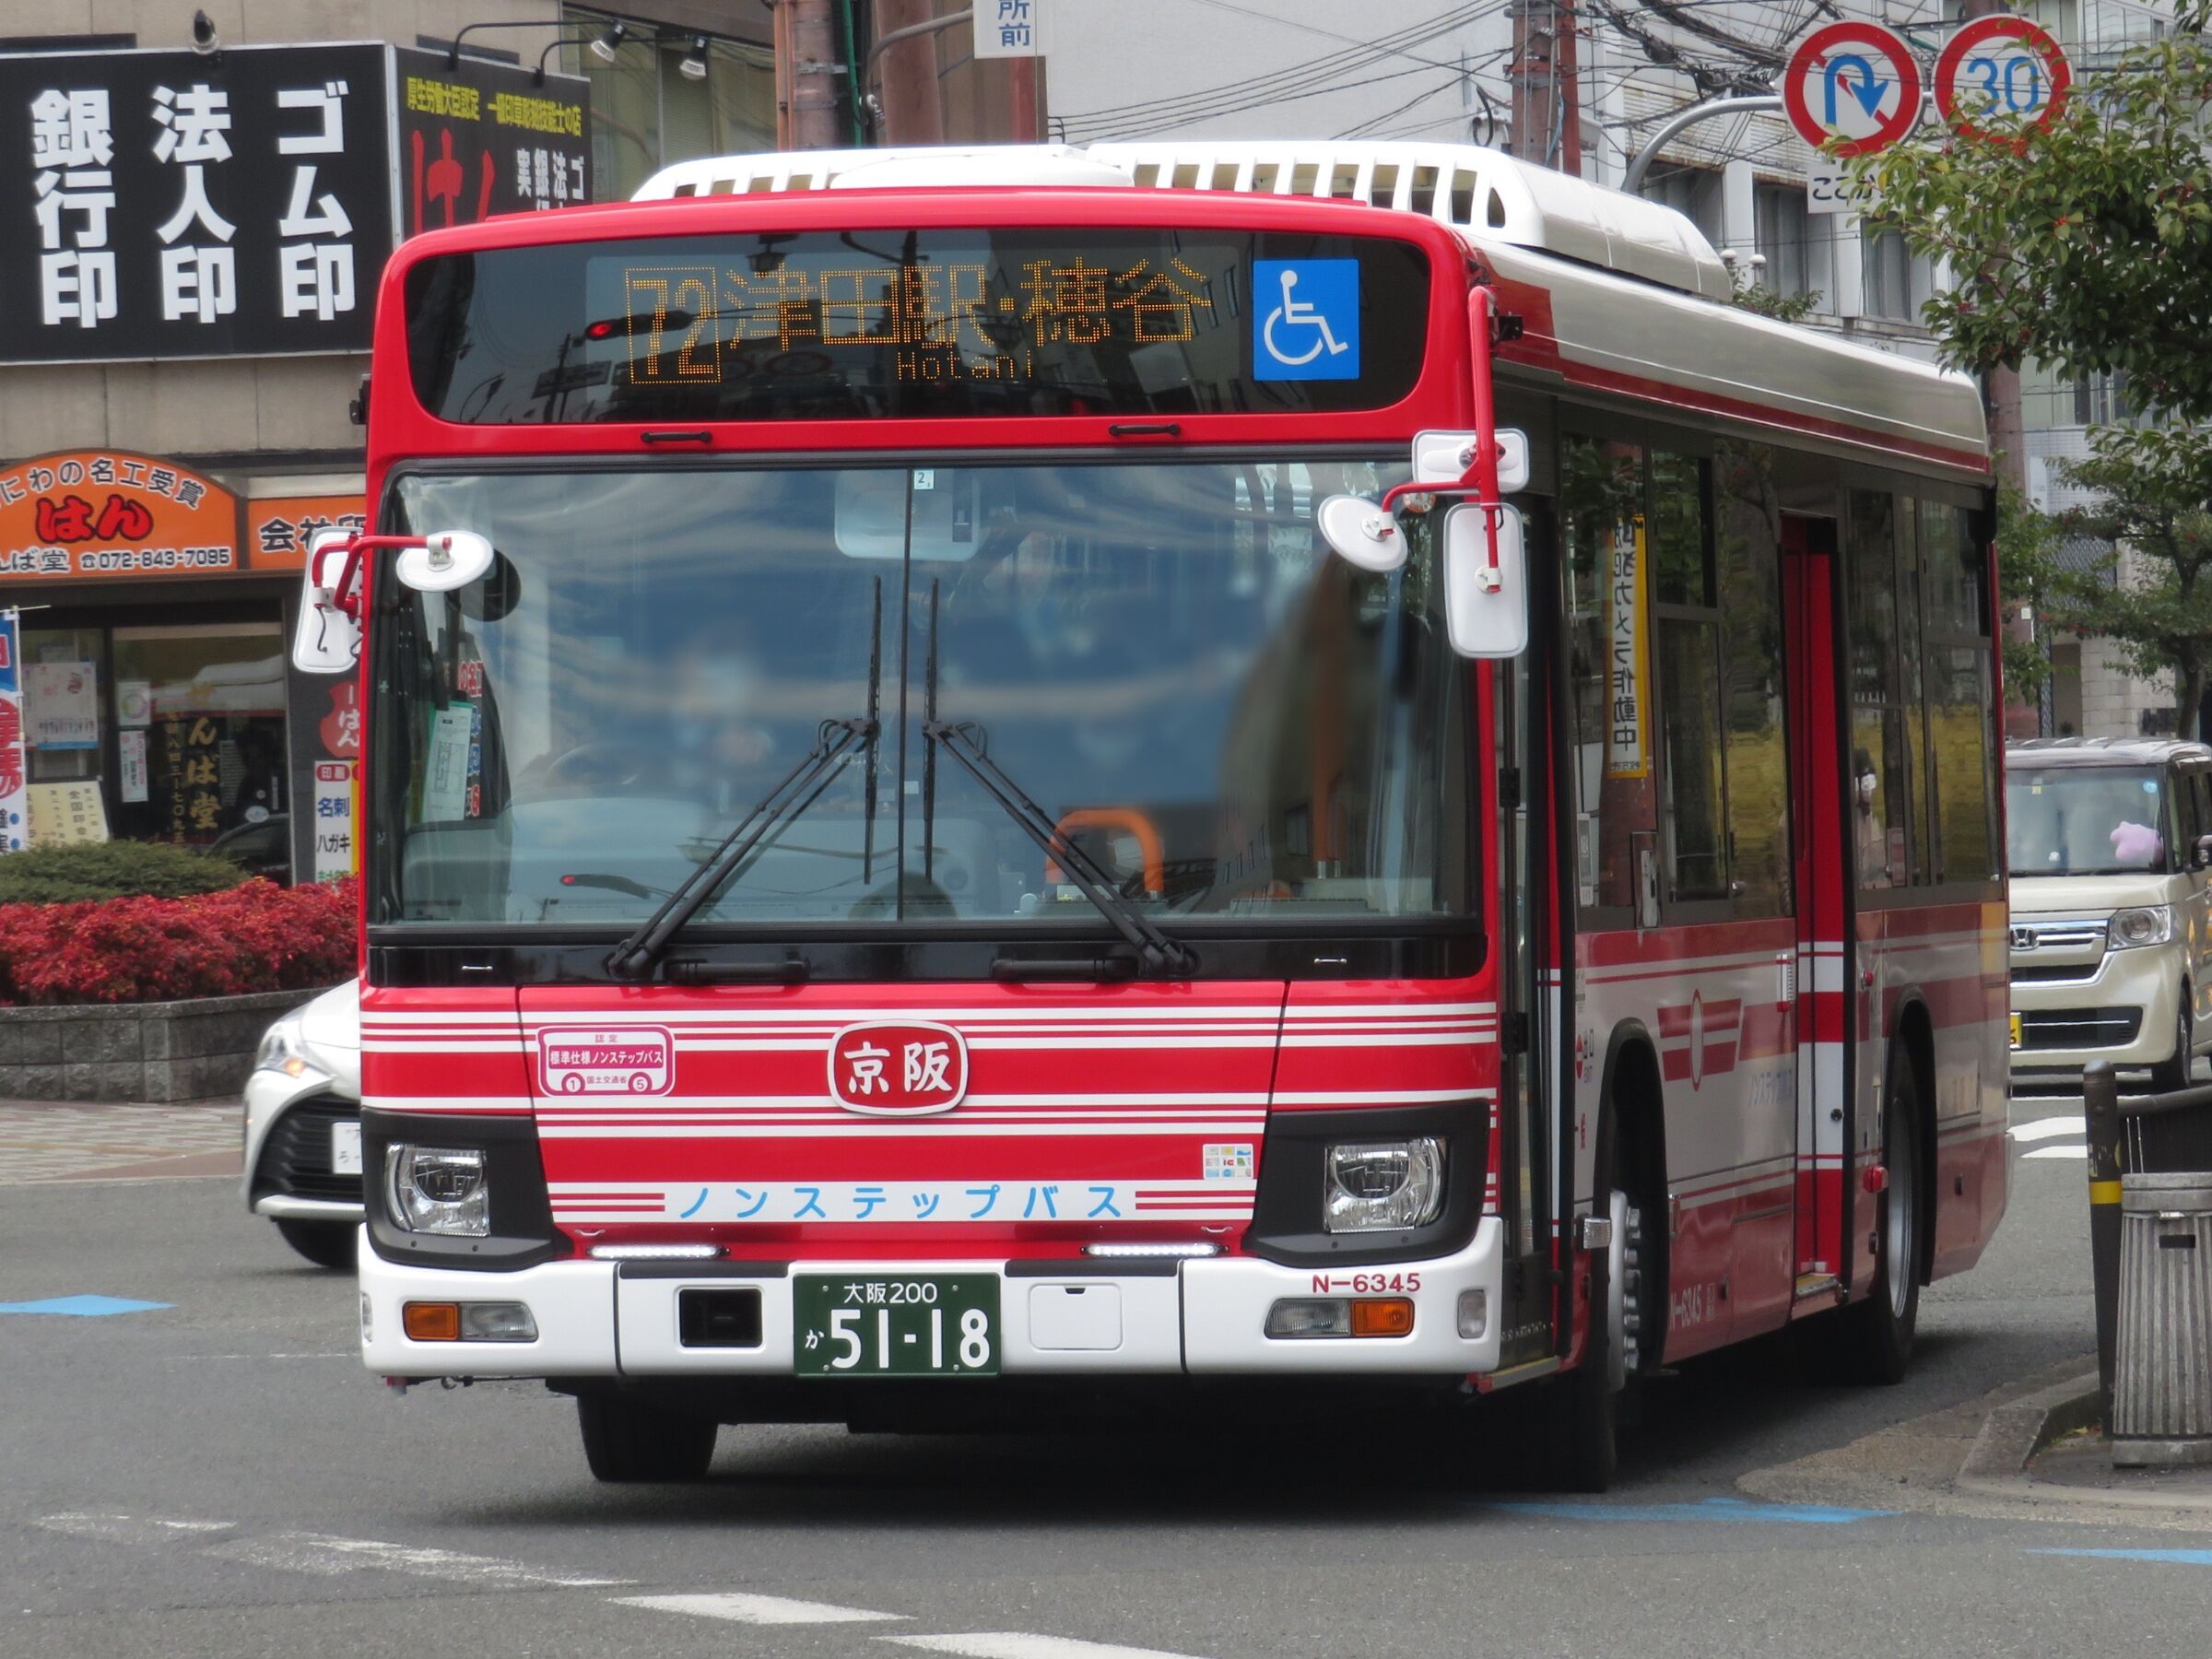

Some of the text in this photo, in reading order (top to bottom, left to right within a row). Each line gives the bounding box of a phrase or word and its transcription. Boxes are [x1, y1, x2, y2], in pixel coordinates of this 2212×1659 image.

[1967, 55, 2040, 115] 30
[31, 89, 117, 328] 銀行印
[152, 84, 237, 324] 法人印
[276, 80, 357, 322] ゴム印
[632, 279, 715, 376] 72
[724, 256, 1213, 351] 津田駅・穂谷
[897, 350, 1032, 380] Hotani
[36, 494, 154, 544] はん
[99, 547, 230, 569] 072-843-7095
[318, 797, 350, 818] 名刺
[317, 833, 350, 853] ハガキ
[550, 1050, 663, 1065] 標準仕様ノンステップバス
[842, 1041, 954, 1095] 京阪
[680, 1185, 1122, 1219] ノンステップバス
[1312, 1272, 1421, 1293] N-6345
[805, 1308, 990, 1369] か 51-18
